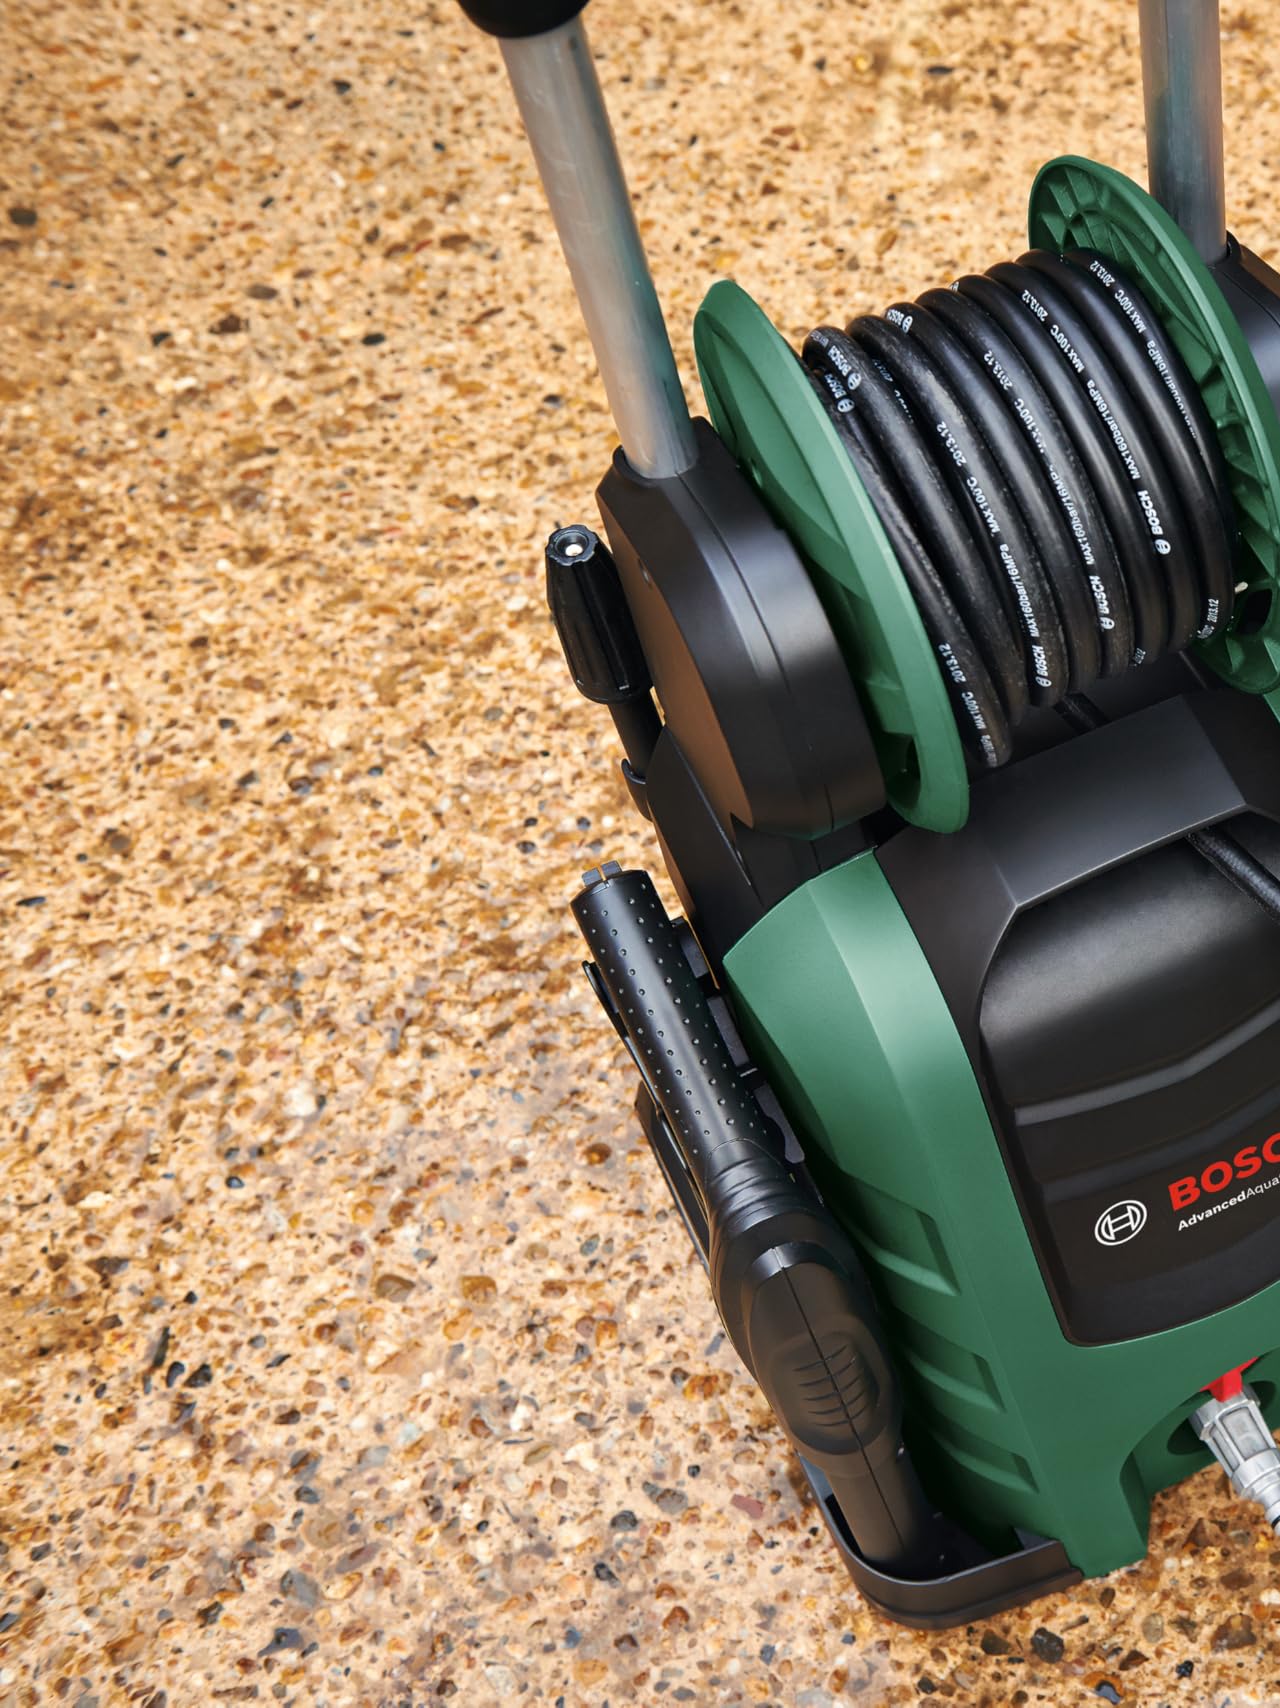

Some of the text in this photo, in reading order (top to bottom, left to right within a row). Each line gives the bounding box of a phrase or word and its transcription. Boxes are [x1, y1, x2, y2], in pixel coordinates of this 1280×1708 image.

[1089, 260, 1116, 287] 2013.12
[1021, 289, 1049, 322] 2013.12
[827, 345, 852, 377] BOSCH
[983, 350, 1013, 390] 2013.12
[936, 421, 968, 467] 2013.12
[1086, 379, 1141, 480] MAX160bar/16MPa
[1137, 490, 1164, 536] BOSCH
[1000, 543, 1040, 638] MAX160bar/16MPa
[1089, 575, 1110, 615] BOSCH
[939, 643, 967, 684] 2013.12
[1031, 644, 1049, 677] BOSCH
